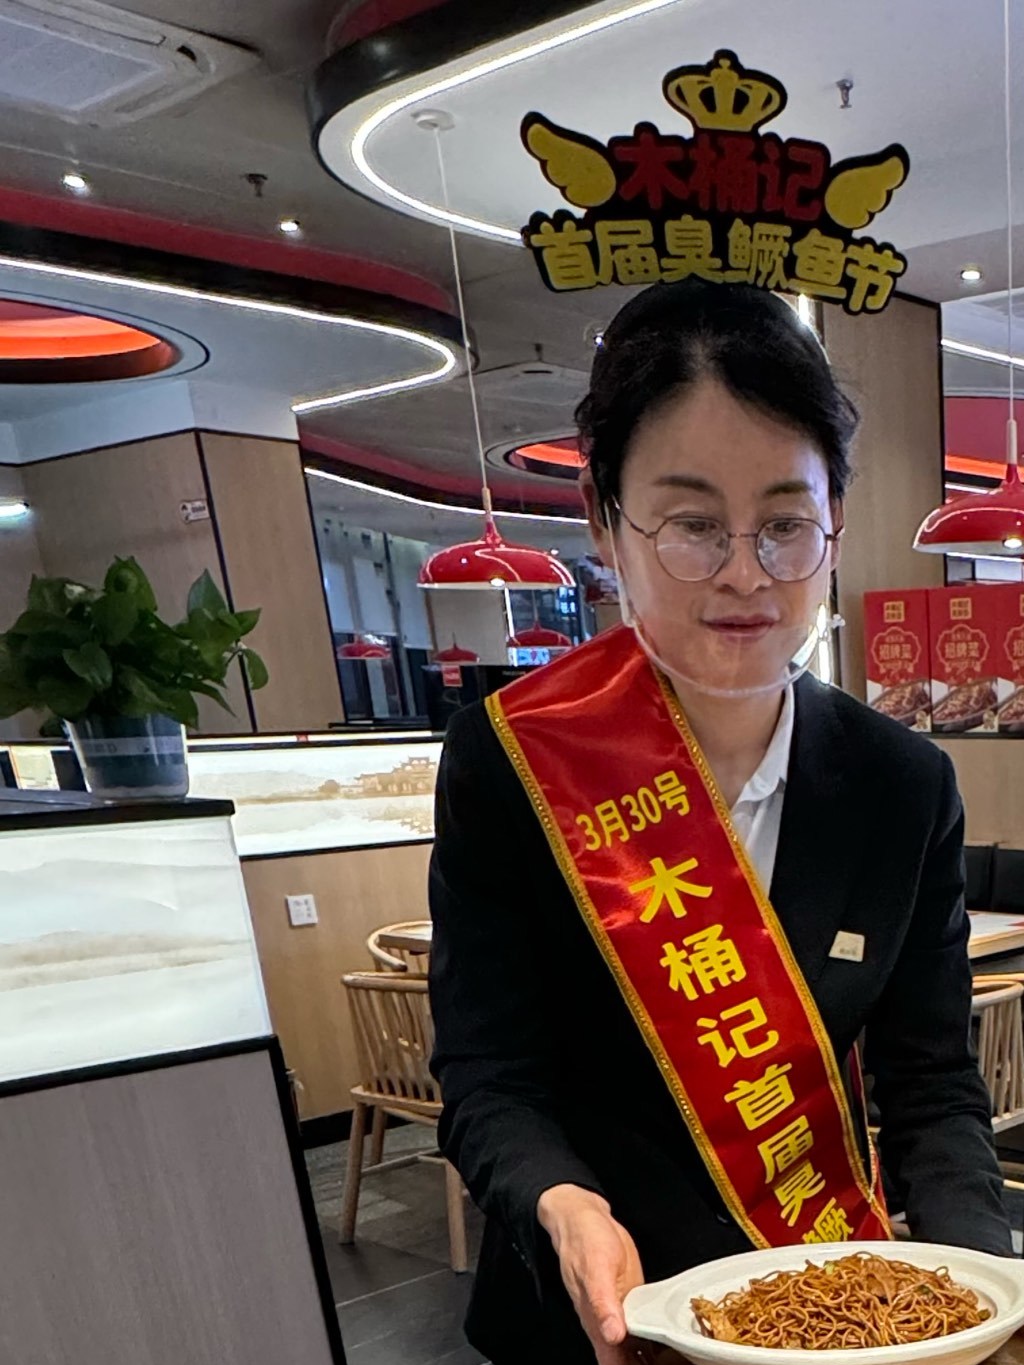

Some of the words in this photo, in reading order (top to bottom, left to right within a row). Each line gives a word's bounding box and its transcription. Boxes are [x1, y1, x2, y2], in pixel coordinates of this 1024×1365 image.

[614, 133, 826, 222] 木桶记
[530, 214, 905, 313] 首届臭鳜鱼节
[575, 769, 691, 851] 3月30号
